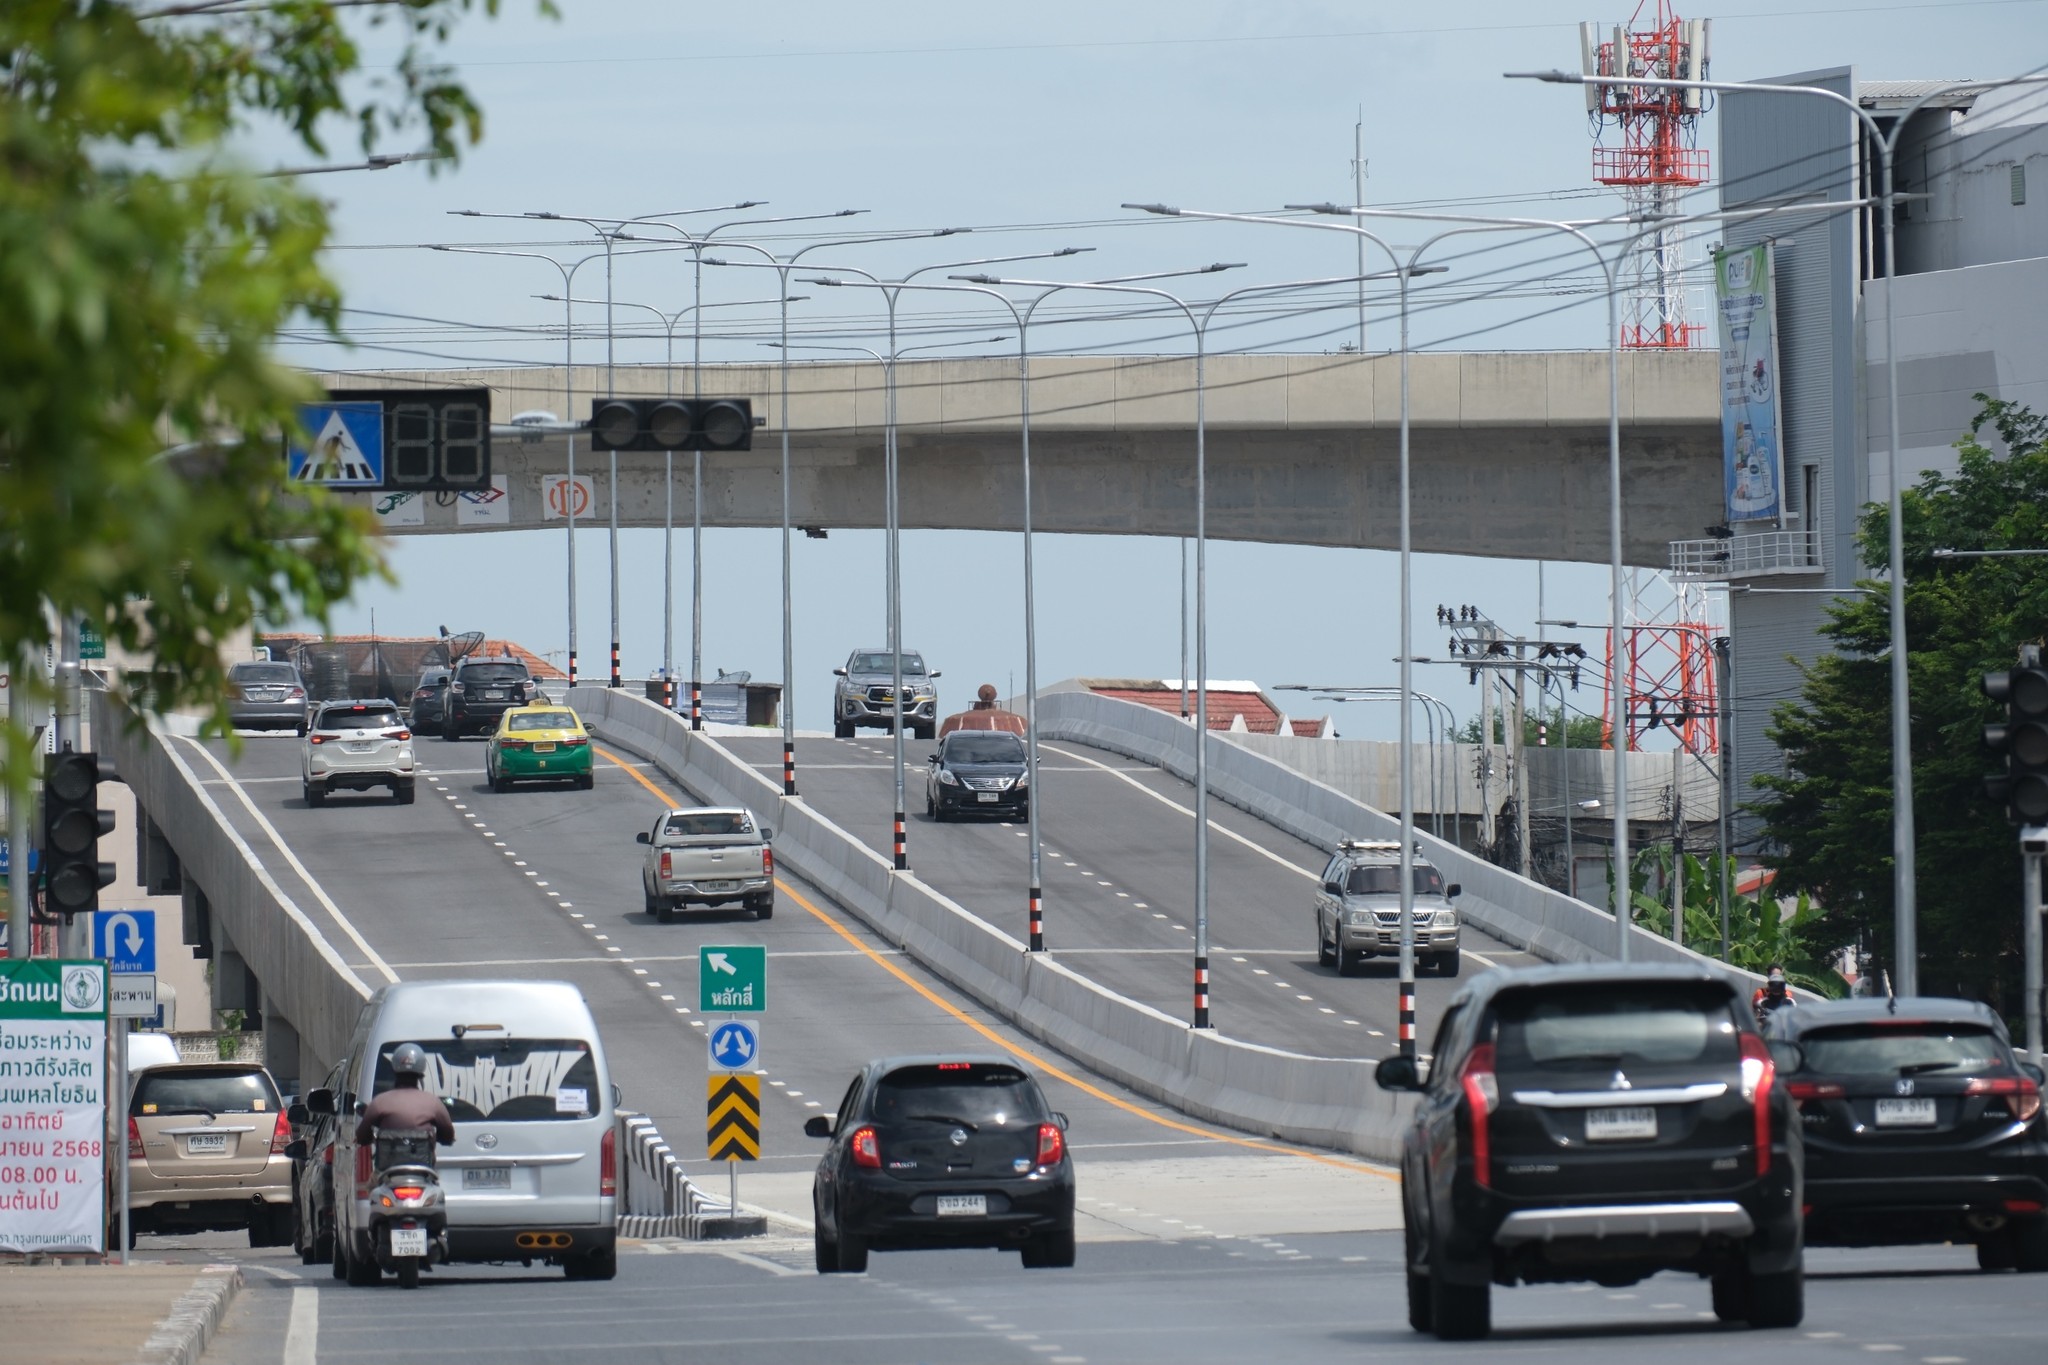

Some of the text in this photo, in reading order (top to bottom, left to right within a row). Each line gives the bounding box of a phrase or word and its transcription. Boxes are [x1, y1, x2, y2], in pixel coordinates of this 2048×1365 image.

[111, 988, 152, 1001] สะพาน
[711, 982, 753, 1006] หลักสี่
[2, 1110, 64, 1130] อาทิตย์
[52, 1140, 101, 1157] 2568
[204, 1135, 224, 1146] 3932
[1, 1166, 83, 1184] 08.00 น.
[13, 1233, 93, 1247] กรุงเทพมหานคร
